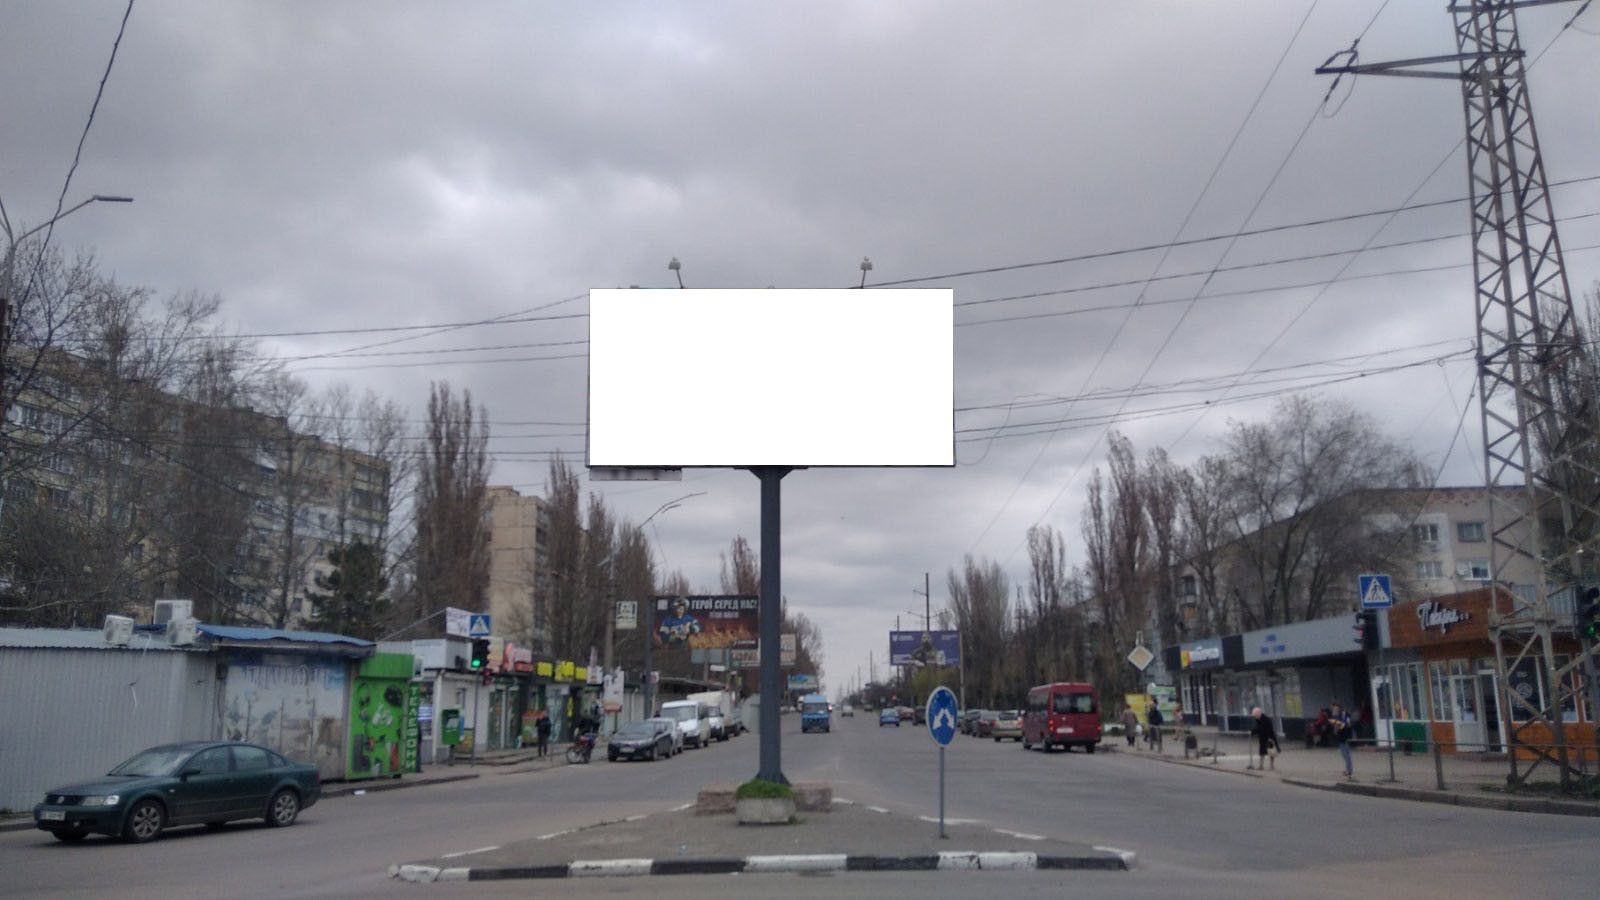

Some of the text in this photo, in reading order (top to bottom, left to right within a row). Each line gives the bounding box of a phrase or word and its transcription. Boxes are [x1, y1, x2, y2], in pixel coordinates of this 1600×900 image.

[692, 598, 757, 610] ГЕРОЙ СЕРЕД НАС!
